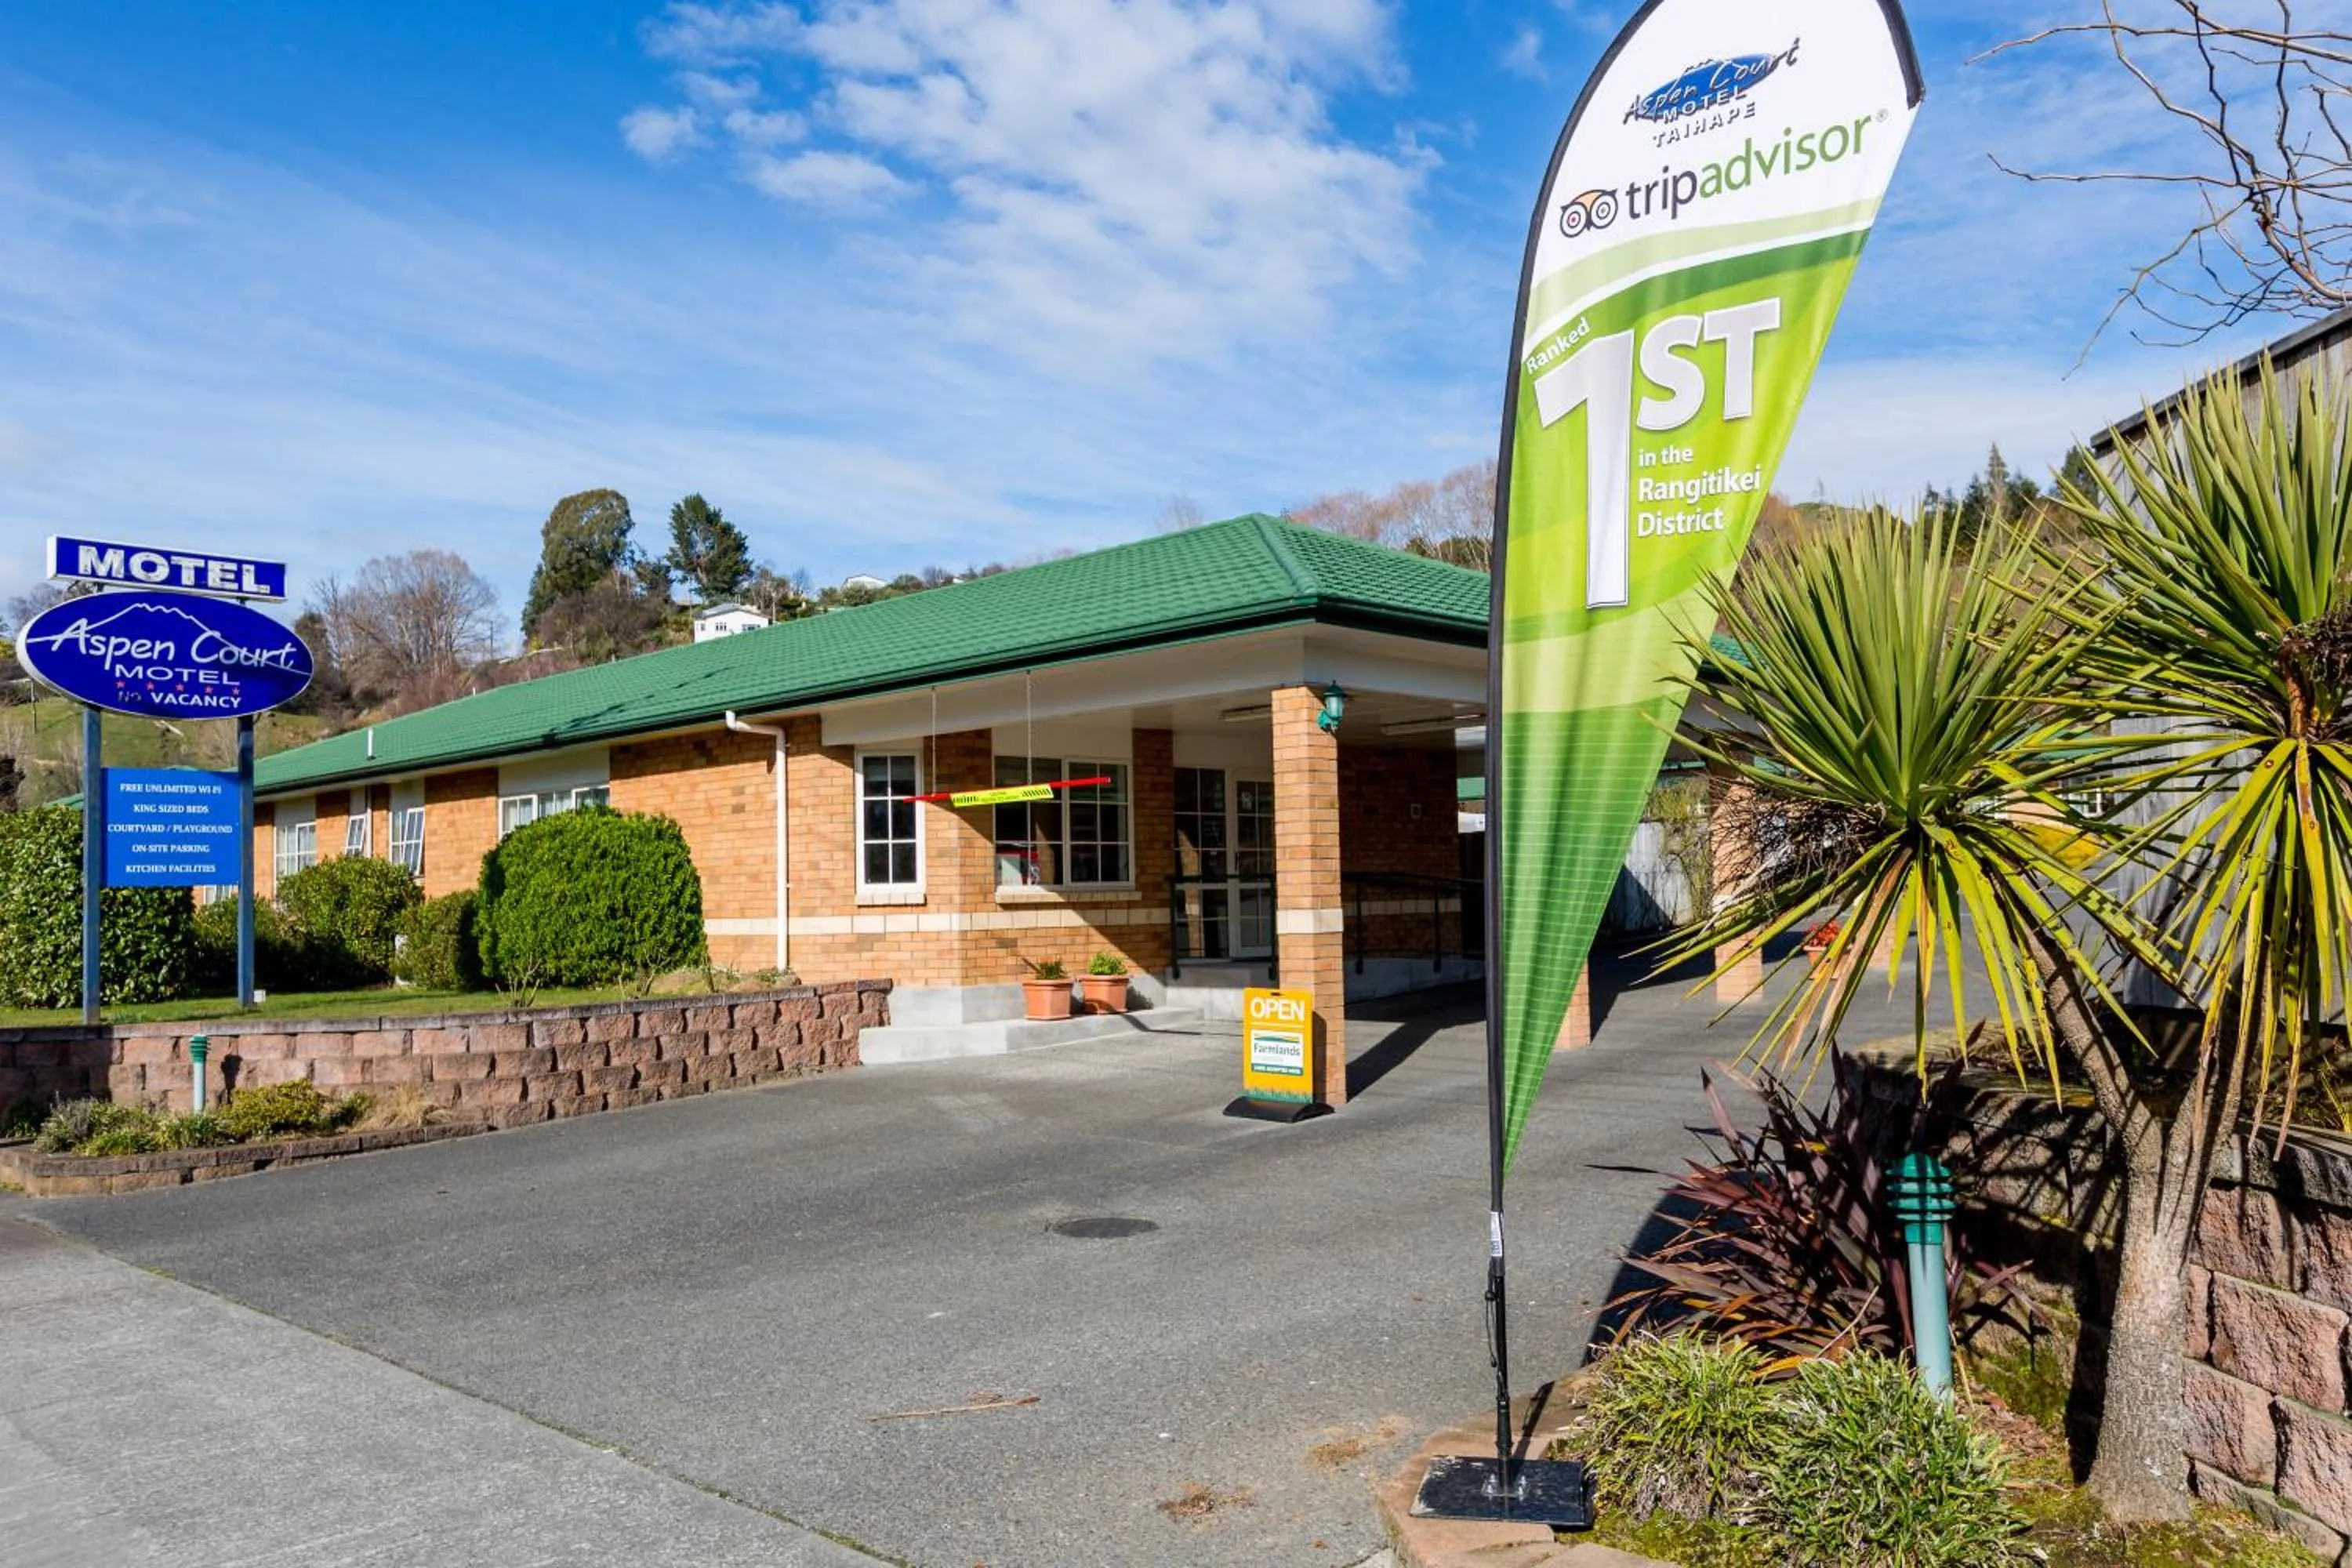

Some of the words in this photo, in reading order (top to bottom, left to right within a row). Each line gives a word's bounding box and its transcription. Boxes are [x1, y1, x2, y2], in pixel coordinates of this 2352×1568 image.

[1661, 85, 1748, 124] MOTEL
[1652, 100, 1756, 148] TAIHAPE
[1625, 114, 1871, 220] tripadvisor
[1526, 317, 1592, 375] Ranked
[1639, 448, 1657, 467] in
[1661, 445, 1693, 464] the
[1638, 464, 1762, 504] Rangitikei
[1638, 506, 1724, 537] District
[78, 545, 270, 595] MOTEL
[51, 618, 176, 671] Aspen
[191, 630, 297, 670] Court
[114, 663, 241, 686] MOTEL
[151, 691, 241, 709] VACANCY
[120, 783, 142, 793] FREE
[145, 784, 197, 794] UNLIMITED
[133, 804, 157, 813] KING
[158, 804, 184, 814] SIZED
[187, 805, 209, 814] BEDS
[107, 824, 165, 833] COURTYARD
[172, 825, 233, 833] PLAYGROUND
[132, 844, 169, 853] ON-SITE
[170, 844, 210, 853] PARKING
[125, 865, 167, 873] KITCHEN
[1250, 997, 1305, 1021] OPEN
[1254, 1042, 1301, 1057] Farmlands
